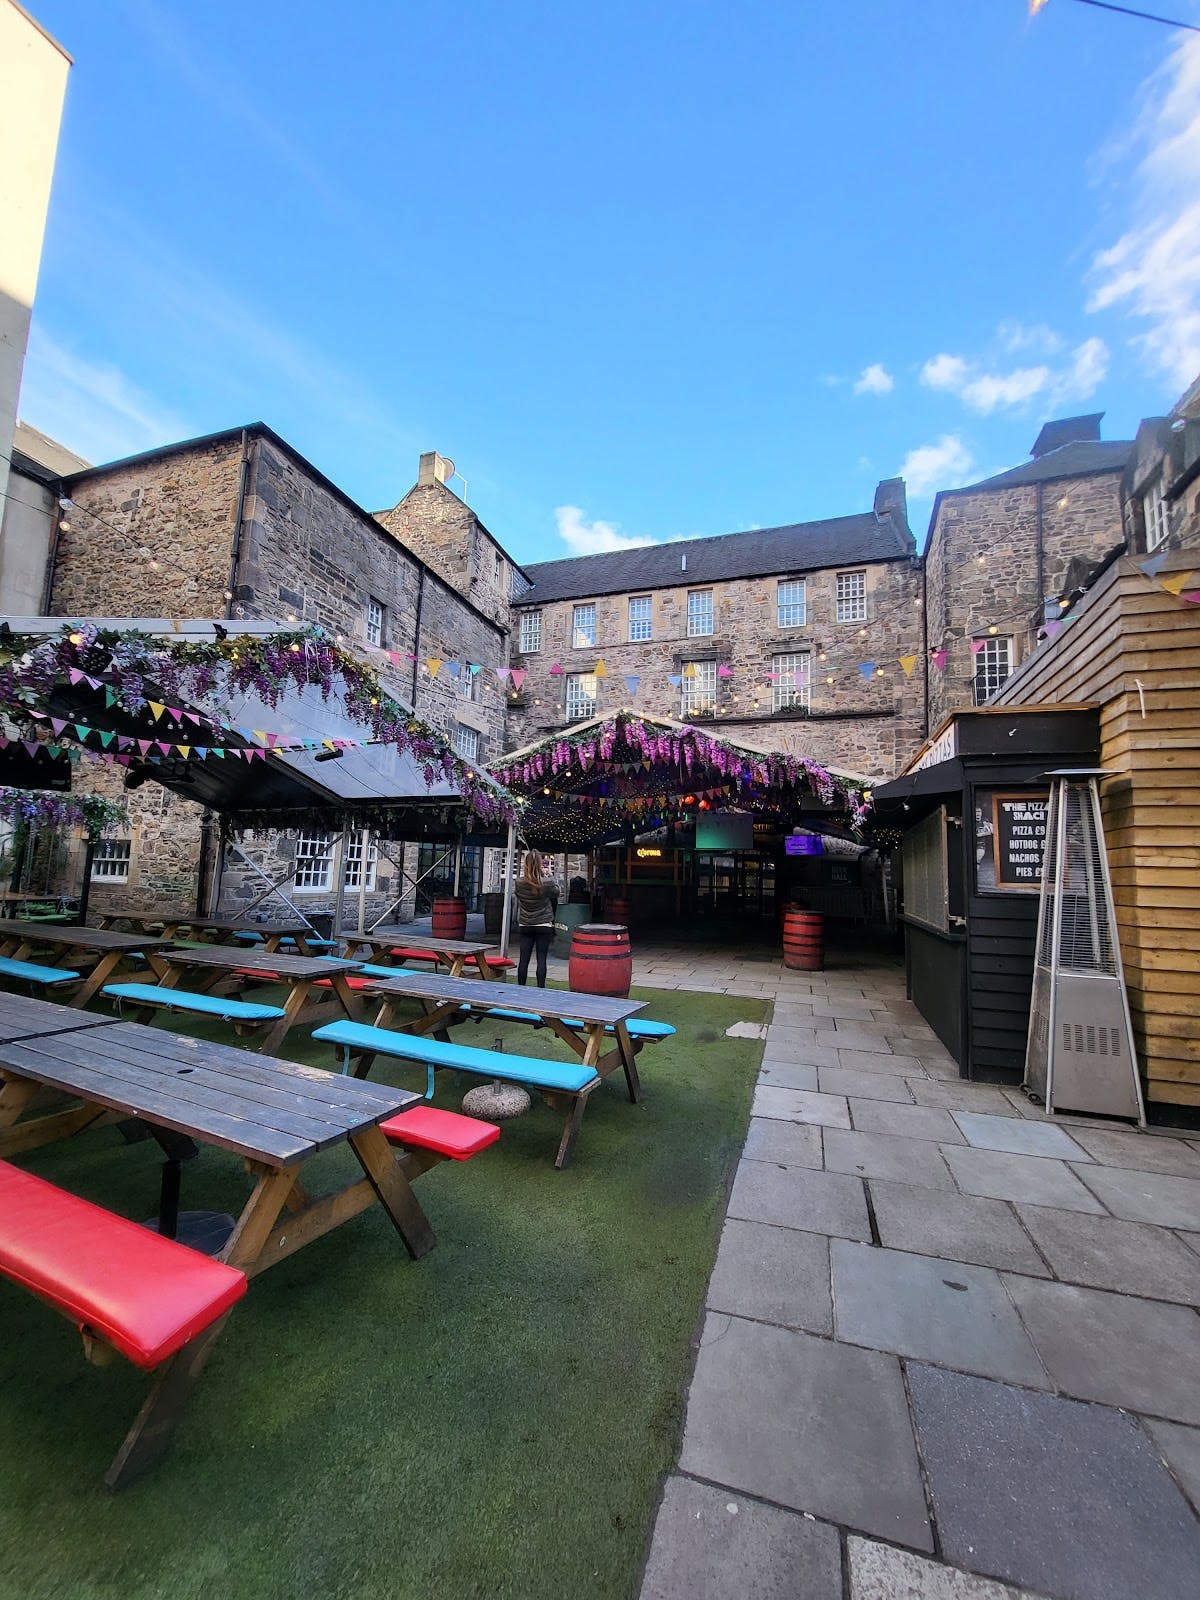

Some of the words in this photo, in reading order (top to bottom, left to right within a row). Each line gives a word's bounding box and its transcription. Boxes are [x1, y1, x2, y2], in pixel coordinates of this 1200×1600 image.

[1002, 802, 1026, 811] THE
[1013, 812, 1045, 821] SHACK
[1012, 826, 1033, 836] PIZZA
[1035, 826, 1046, 836] £9
[1009, 840, 1038, 849] HOTDOG
[637, 848, 661, 858] Corona
[1009, 854, 1040, 863] NACHOS
[1016, 867, 1033, 877] PIES
